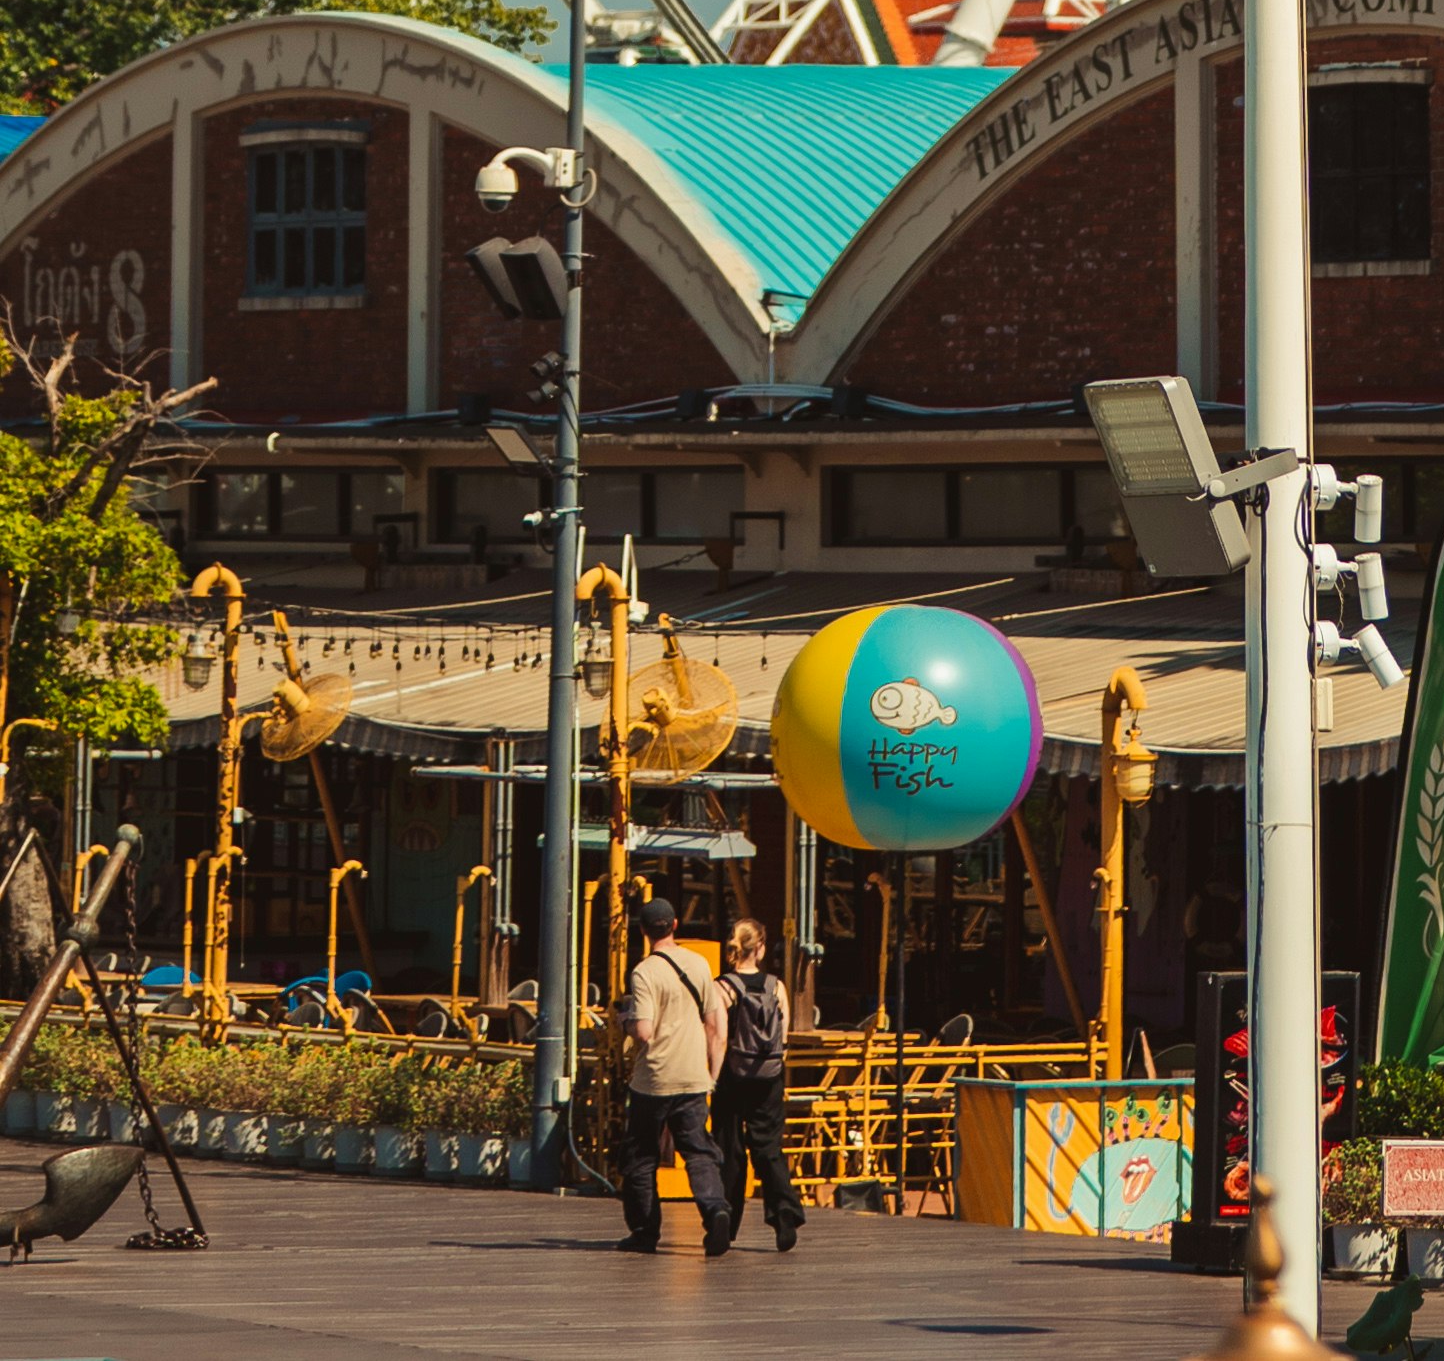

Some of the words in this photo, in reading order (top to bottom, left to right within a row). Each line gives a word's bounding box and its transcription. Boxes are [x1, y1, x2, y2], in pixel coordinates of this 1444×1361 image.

[965, 97, 1036, 181] THE
[1043, 27, 1138, 124] EAST
[20, 236, 99, 327] โกดัง
[107, 249, 146, 354] 8
[867, 737, 958, 765] Happy
[867, 762, 954, 796] Fish
